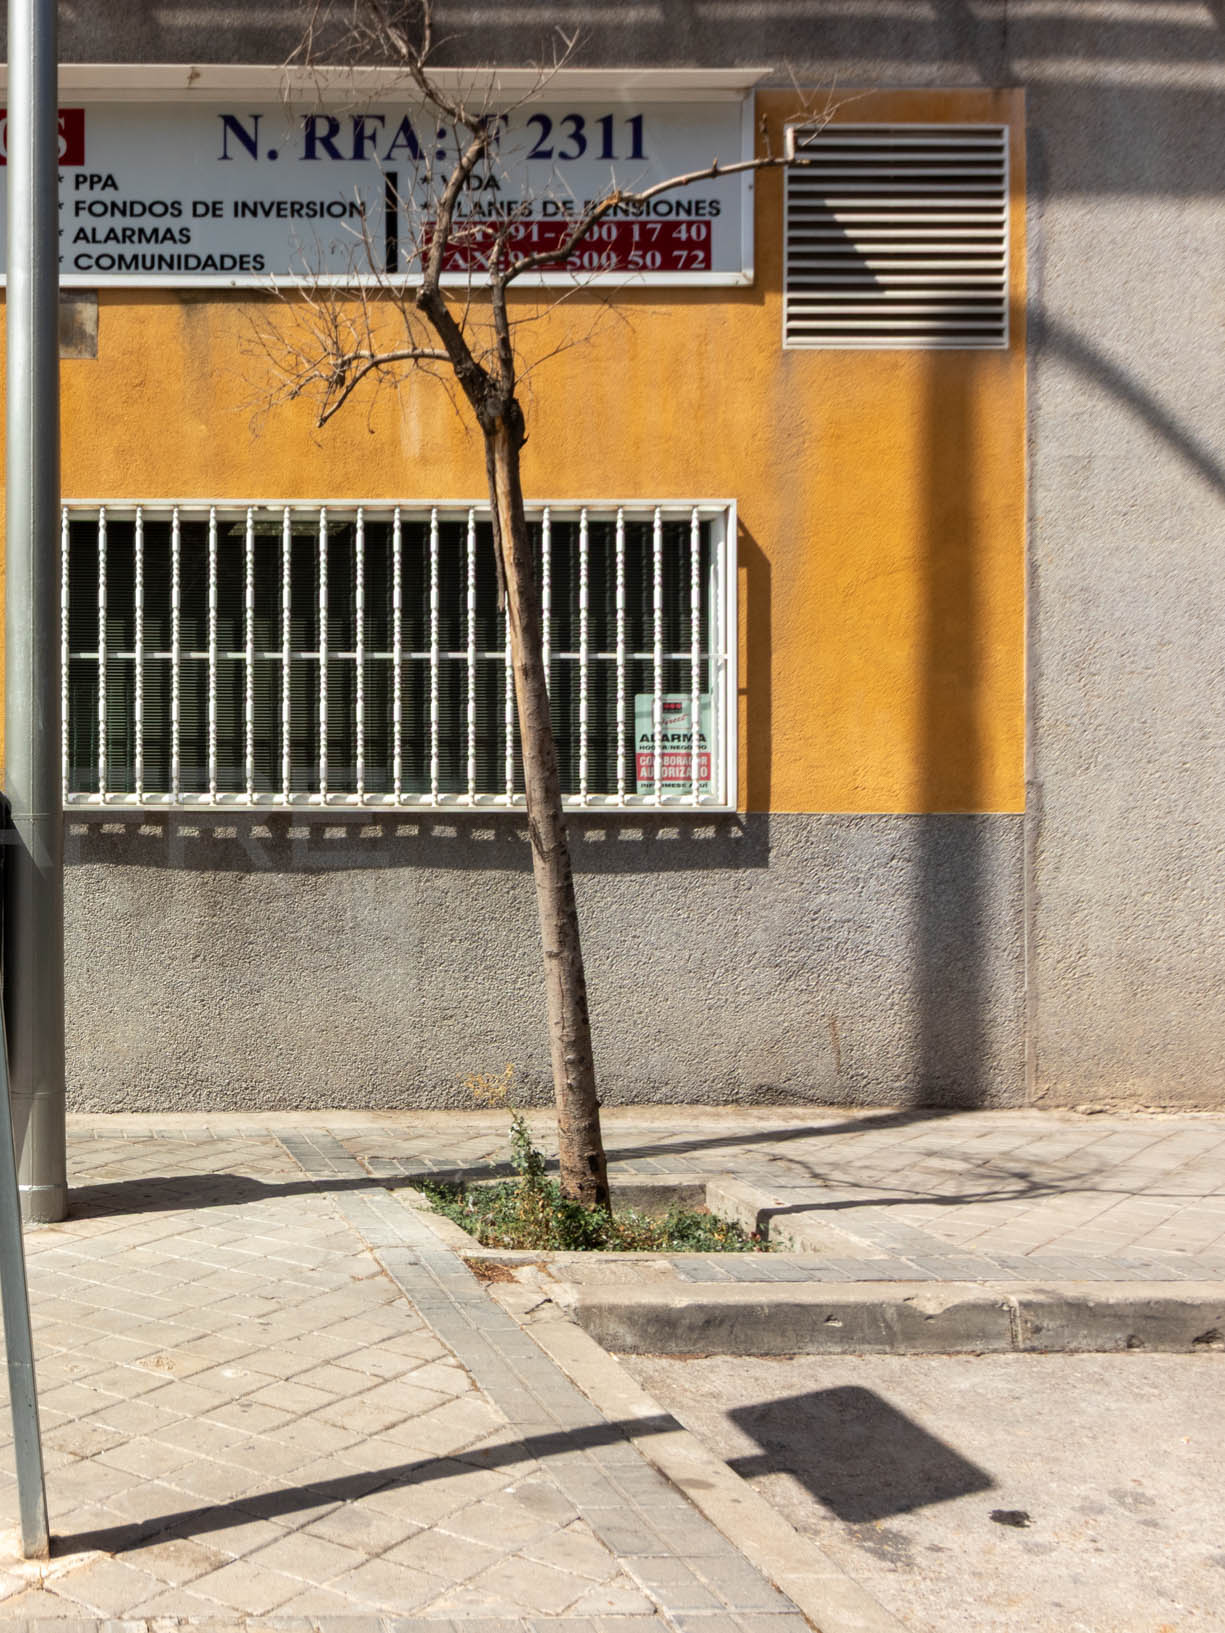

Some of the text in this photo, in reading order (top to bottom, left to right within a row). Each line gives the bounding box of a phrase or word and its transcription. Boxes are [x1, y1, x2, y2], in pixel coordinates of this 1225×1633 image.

[217, 113, 279, 161] N.
[299, 113, 447, 161] RFA:
[526, 113, 650, 161] 2311
[73, 173, 120, 191] PPA
[441, 174, 502, 191] DA
[73, 200, 366, 218] FONDOS DE INVERSION
[444, 200, 534, 218] LANES
[542, 200, 574, 218] DE
[72, 227, 192, 245] ALARMAS
[566, 223, 617, 242] 00
[631, 223, 663, 242] 17
[672, 223, 707, 242] 40
[73, 253, 266, 272] COMUNIDADES
[566, 250, 618, 270] 500
[627, 250, 662, 270] 50
[672, 250, 706, 270] 72
[639, 756, 708, 766] COBORAR
[639, 766, 708, 778] AUORIZAO
